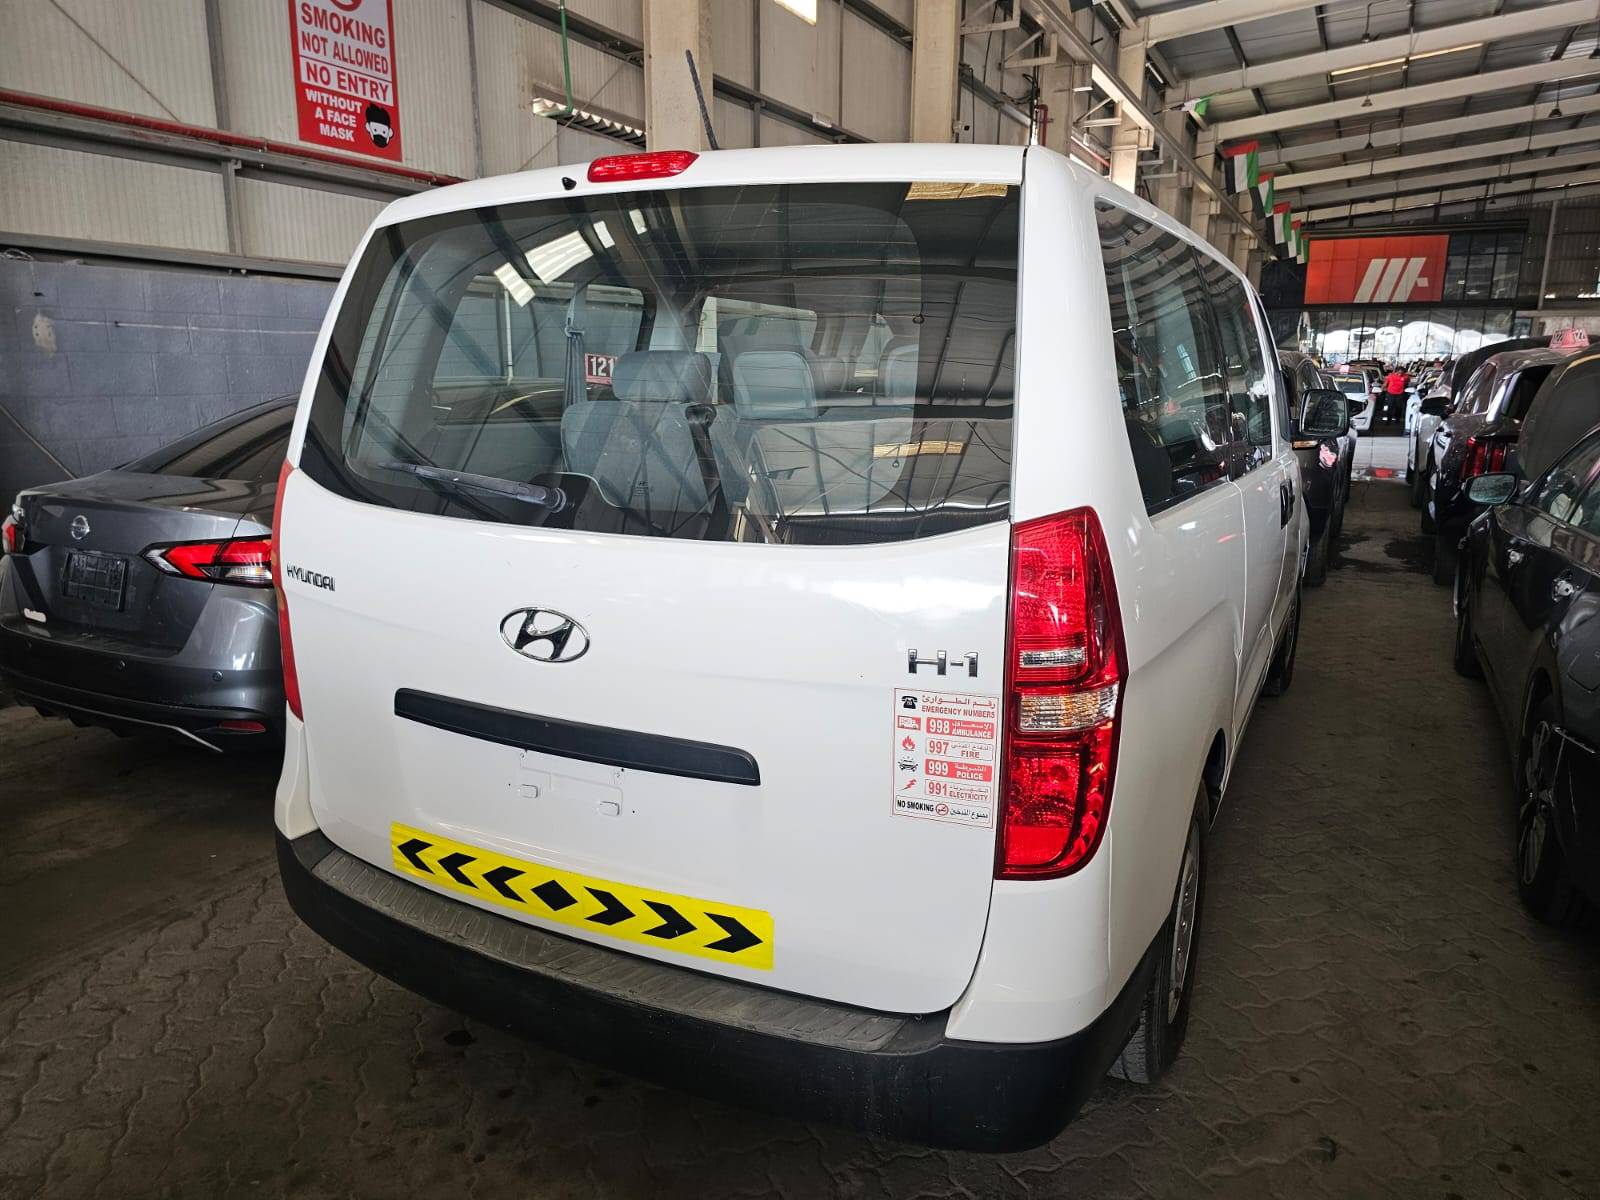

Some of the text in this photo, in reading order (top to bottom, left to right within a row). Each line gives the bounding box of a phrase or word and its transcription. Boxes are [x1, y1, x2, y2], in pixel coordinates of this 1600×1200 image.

[301, 2, 386, 48] SMOKING
[302, 31, 389, 75] NOT ALLOWED
[306, 61, 389, 102] NO ENTRY
[305, 89, 362, 114] WITHOUT
[315, 108, 357, 127] A FACE
[319, 123, 355, 142] MASK
[590, 356, 615, 377] 121
[286, 562, 336, 592] HYUNDAI
[907, 648, 979, 678] H-1
[921, 705, 995, 719] EMERGENCY NUMBERS
[929, 718, 950, 735] 998
[951, 728, 992, 739] AMBULANCE
[929, 740, 949, 754] 997
[961, 750, 980, 758] FIRE
[928, 761, 948, 775] 999
[956, 771, 984, 780] POLICE
[928, 781, 948, 796] 991
[949, 790, 988, 801] ELECTRICITY
[907, 801, 934, 812] SMOKING
